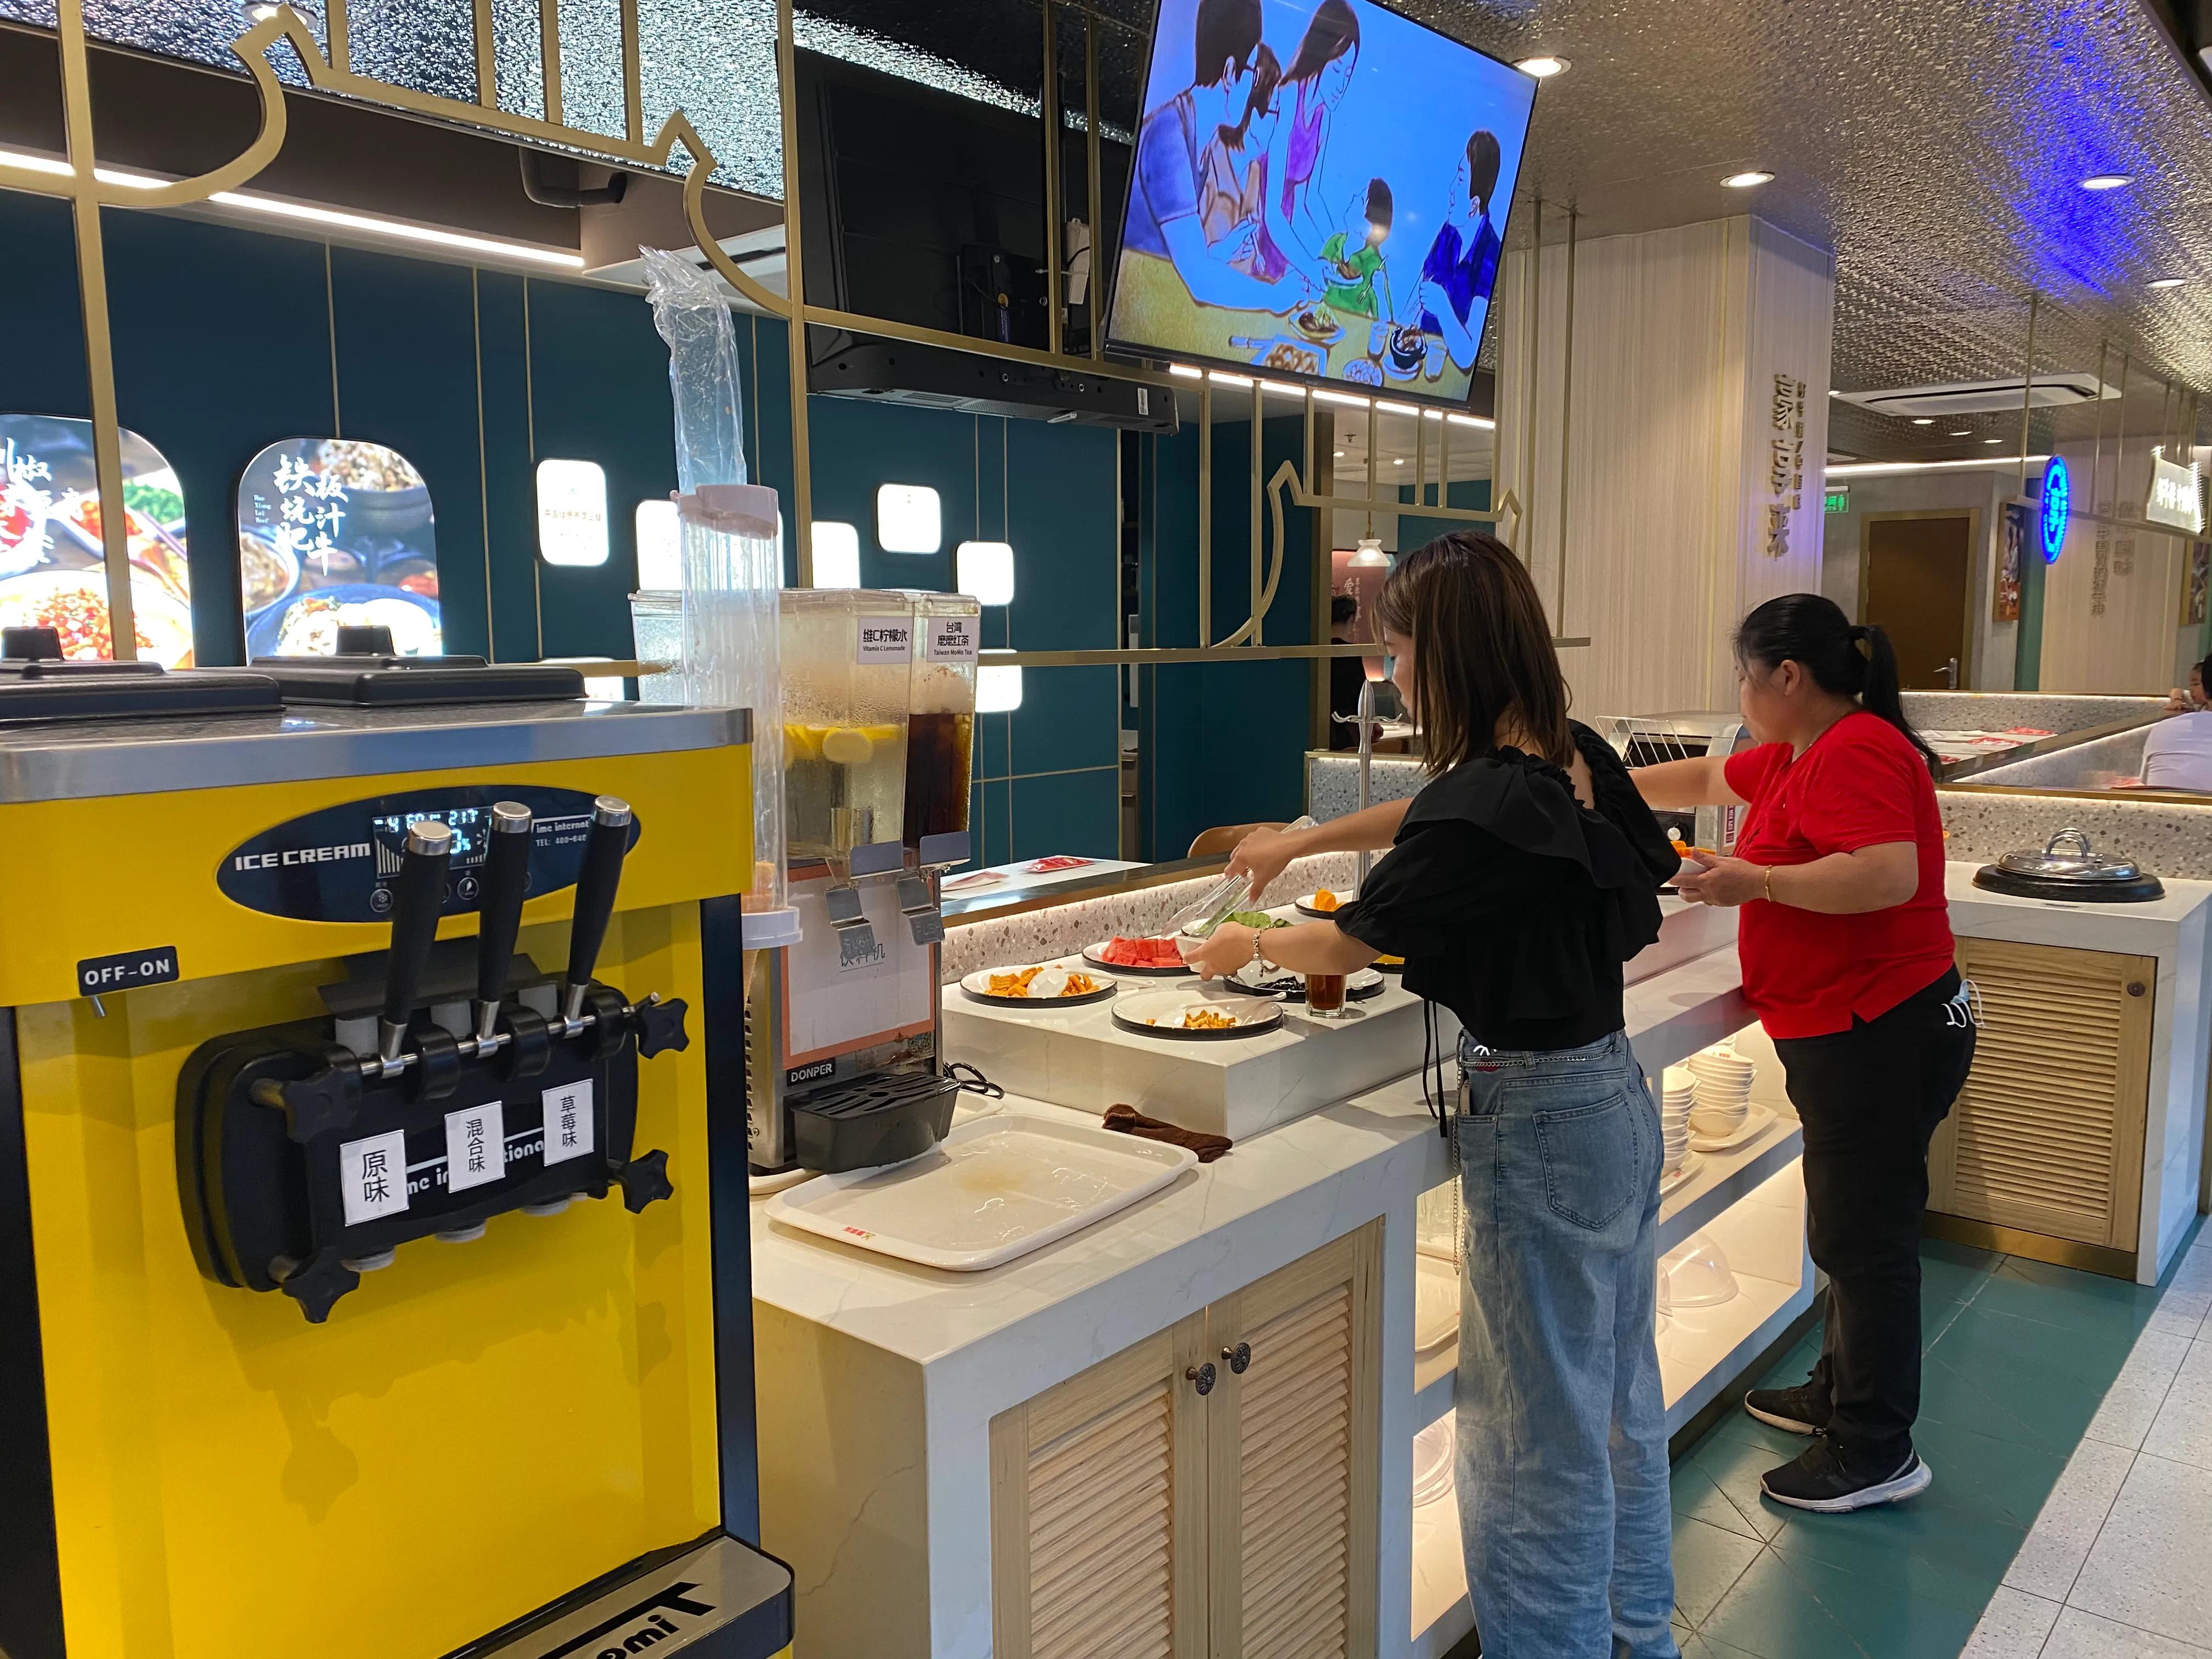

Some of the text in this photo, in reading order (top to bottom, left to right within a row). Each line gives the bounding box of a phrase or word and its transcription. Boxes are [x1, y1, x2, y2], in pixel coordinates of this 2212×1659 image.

[946, 621, 962, 633] 台湾
[235, 843, 371, 871] ICE CREAM
[84, 958, 170, 985] OFF-ON
[790, 1063, 833, 1082] DONPER
[560, 1094, 577, 1148] 草莓味
[465, 1118, 486, 1173] 混合味
[361, 1149, 391, 1203] 原味
